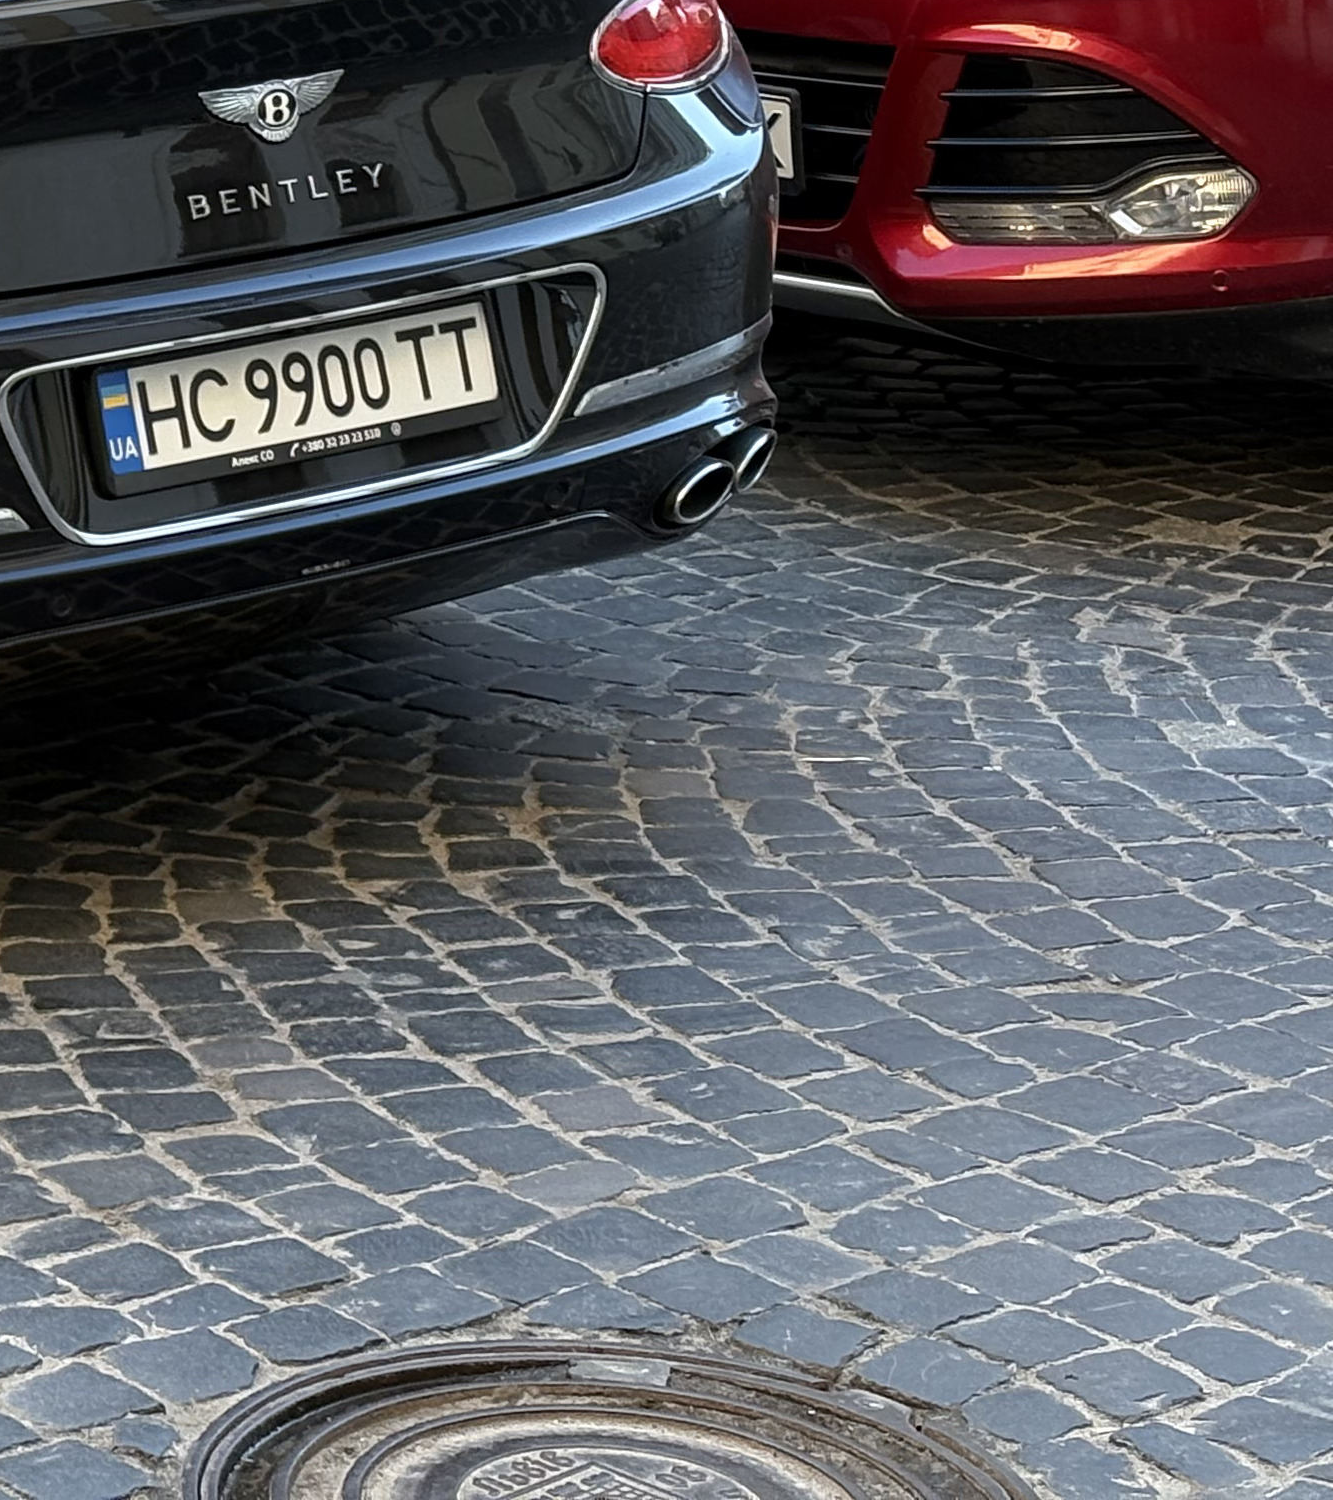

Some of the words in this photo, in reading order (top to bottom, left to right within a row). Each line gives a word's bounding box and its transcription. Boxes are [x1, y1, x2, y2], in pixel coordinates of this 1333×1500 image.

[262, 92, 290, 127] B
[187, 163, 383, 220] BENTLEY
[136, 368, 235, 455] HC
[244, 338, 391, 434] 9900
[395, 316, 478, 401] TT
[109, 435, 139, 461] UA
[338, 434, 351, 446] 23
[351, 431, 363, 443] 23
